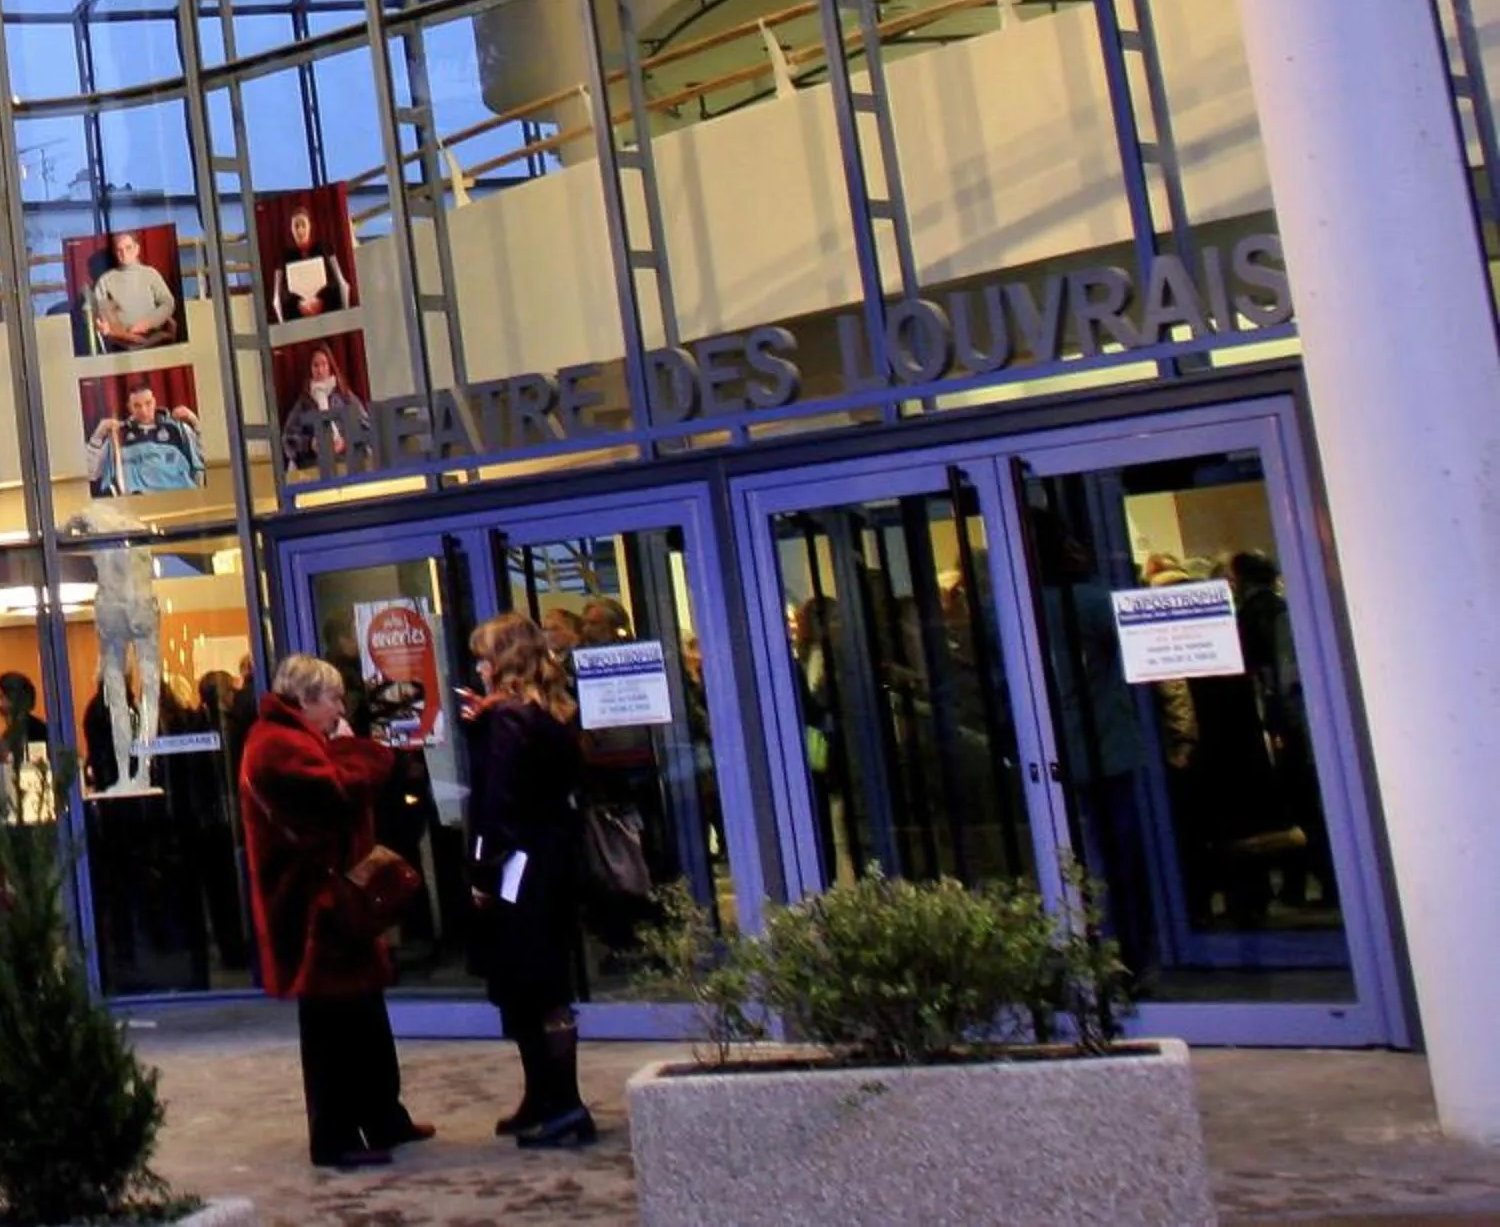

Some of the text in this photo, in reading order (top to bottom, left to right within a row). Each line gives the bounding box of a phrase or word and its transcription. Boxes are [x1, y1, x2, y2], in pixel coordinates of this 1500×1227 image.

[300, 232, 1294, 479] THEATRE DES LOUVRAIS
